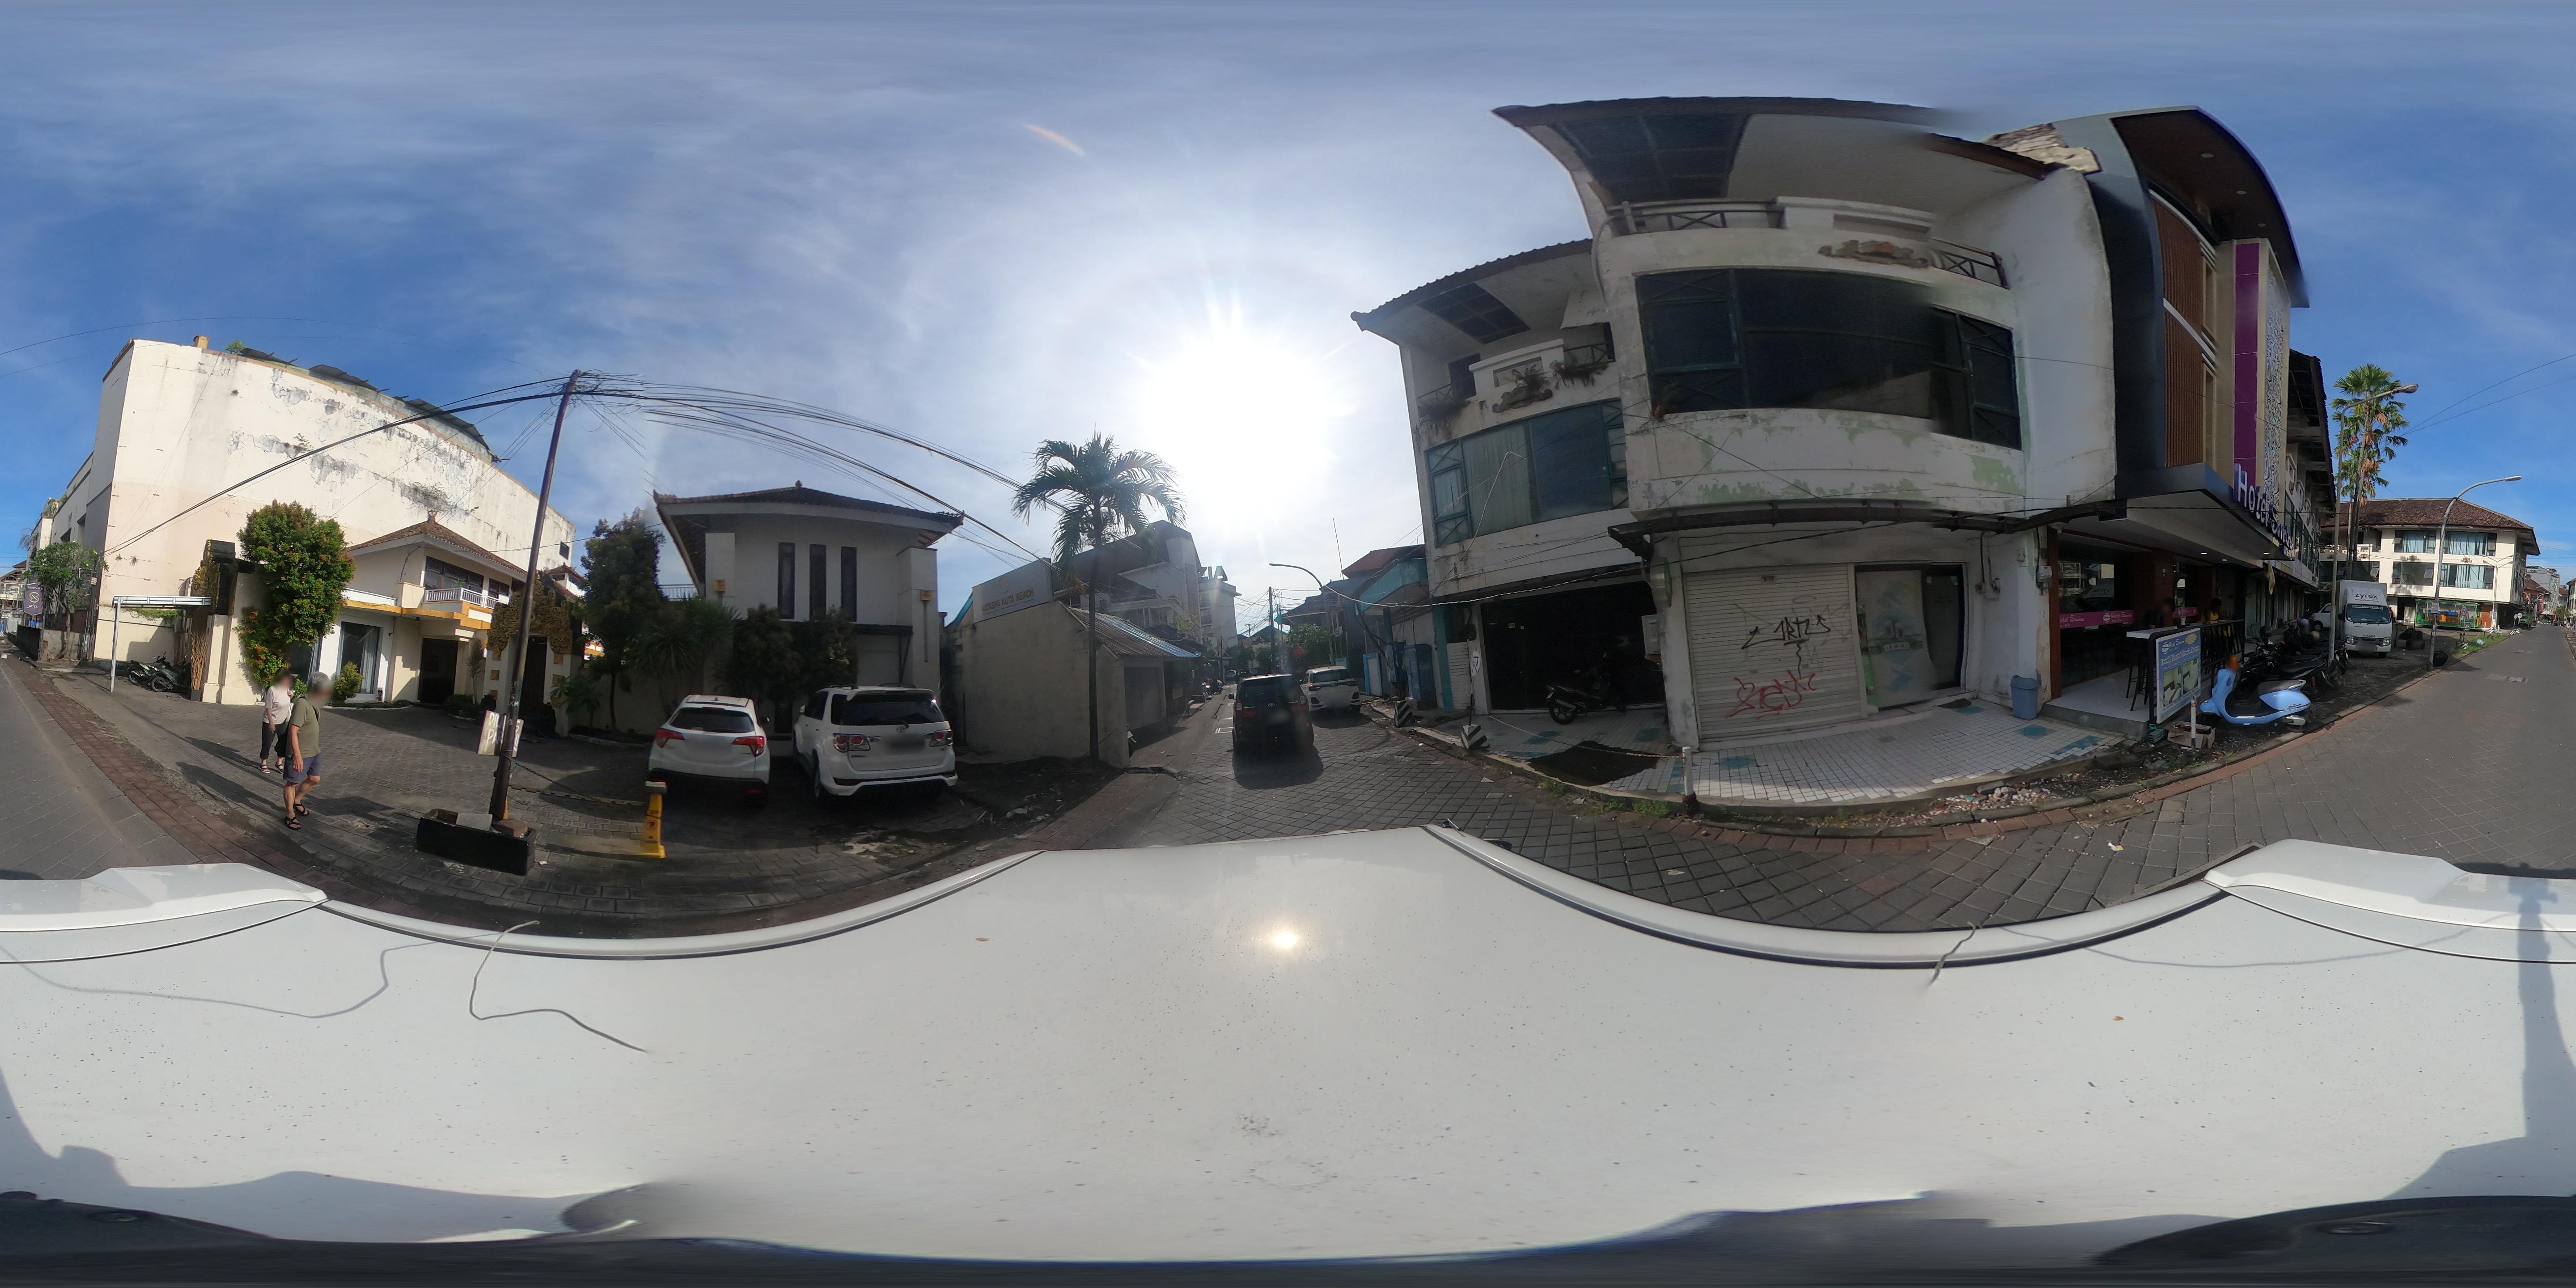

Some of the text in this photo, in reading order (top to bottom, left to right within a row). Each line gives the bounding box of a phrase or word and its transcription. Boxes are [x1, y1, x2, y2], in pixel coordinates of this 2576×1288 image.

[2237, 463, 2269, 527] Hotel
[1002, 595, 1014, 605] KUTA
[1016, 587, 1034, 602] BEACH
